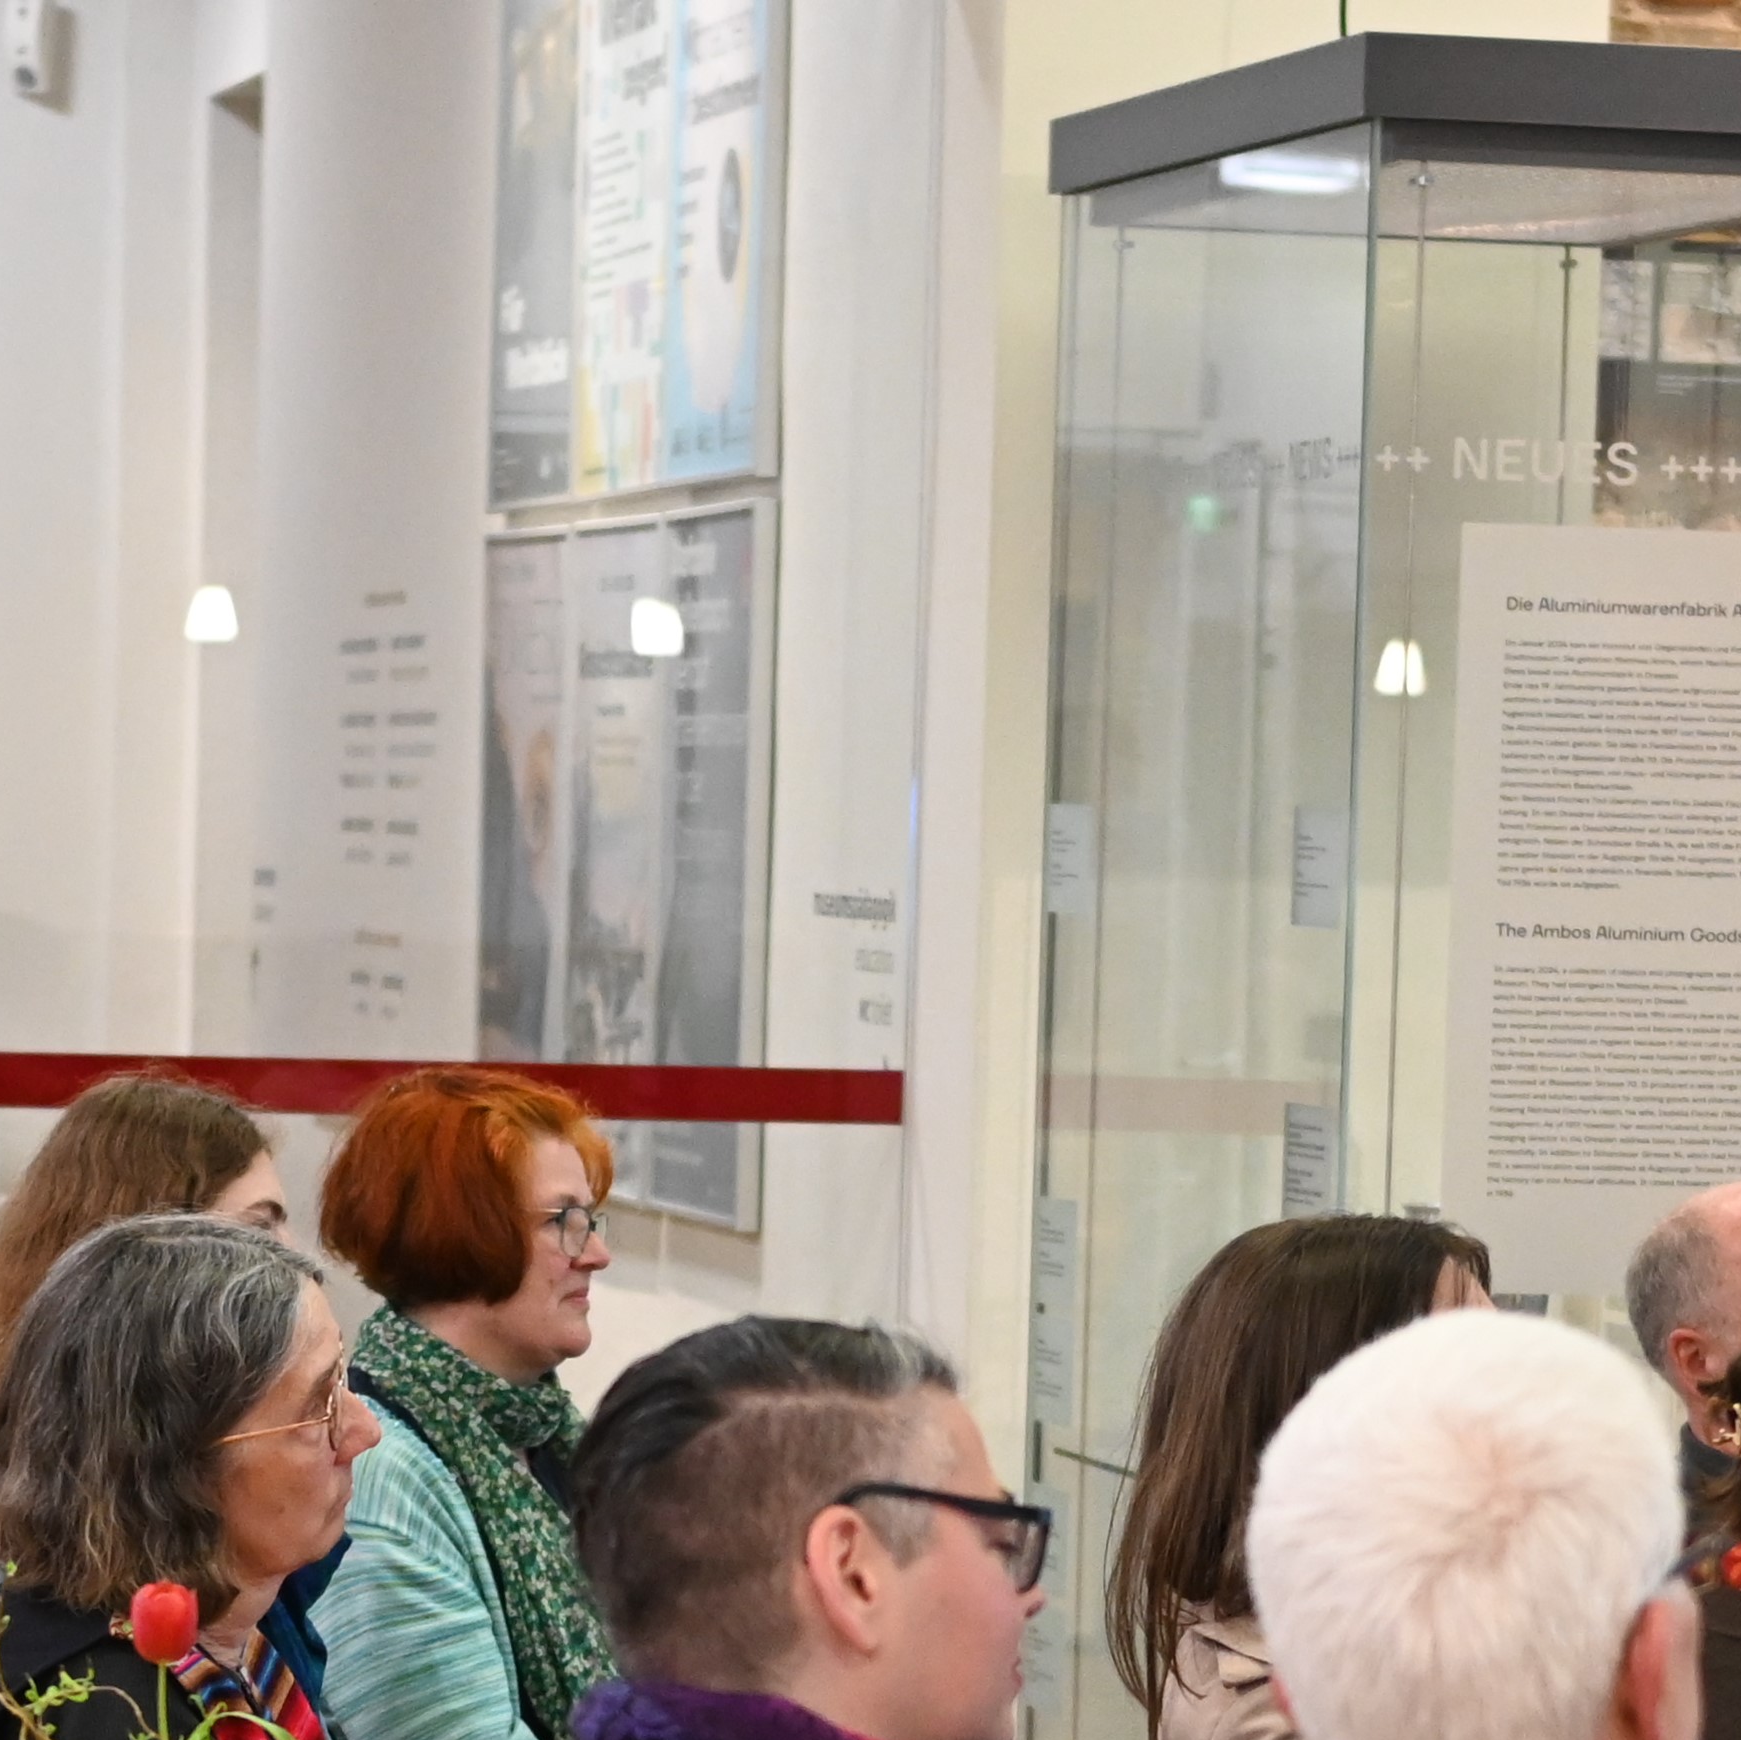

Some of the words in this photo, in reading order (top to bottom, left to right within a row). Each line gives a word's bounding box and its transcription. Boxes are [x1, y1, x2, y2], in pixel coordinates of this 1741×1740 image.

[1451, 436, 1639, 487] NEUES
[1506, 596, 1534, 612] Die
[1538, 597, 1729, 619] Aluminiumwarenfabrik
[1495, 922, 1527, 938] The
[1531, 923, 1591, 940] Ambos
[1595, 925, 1685, 942] Aluminium
